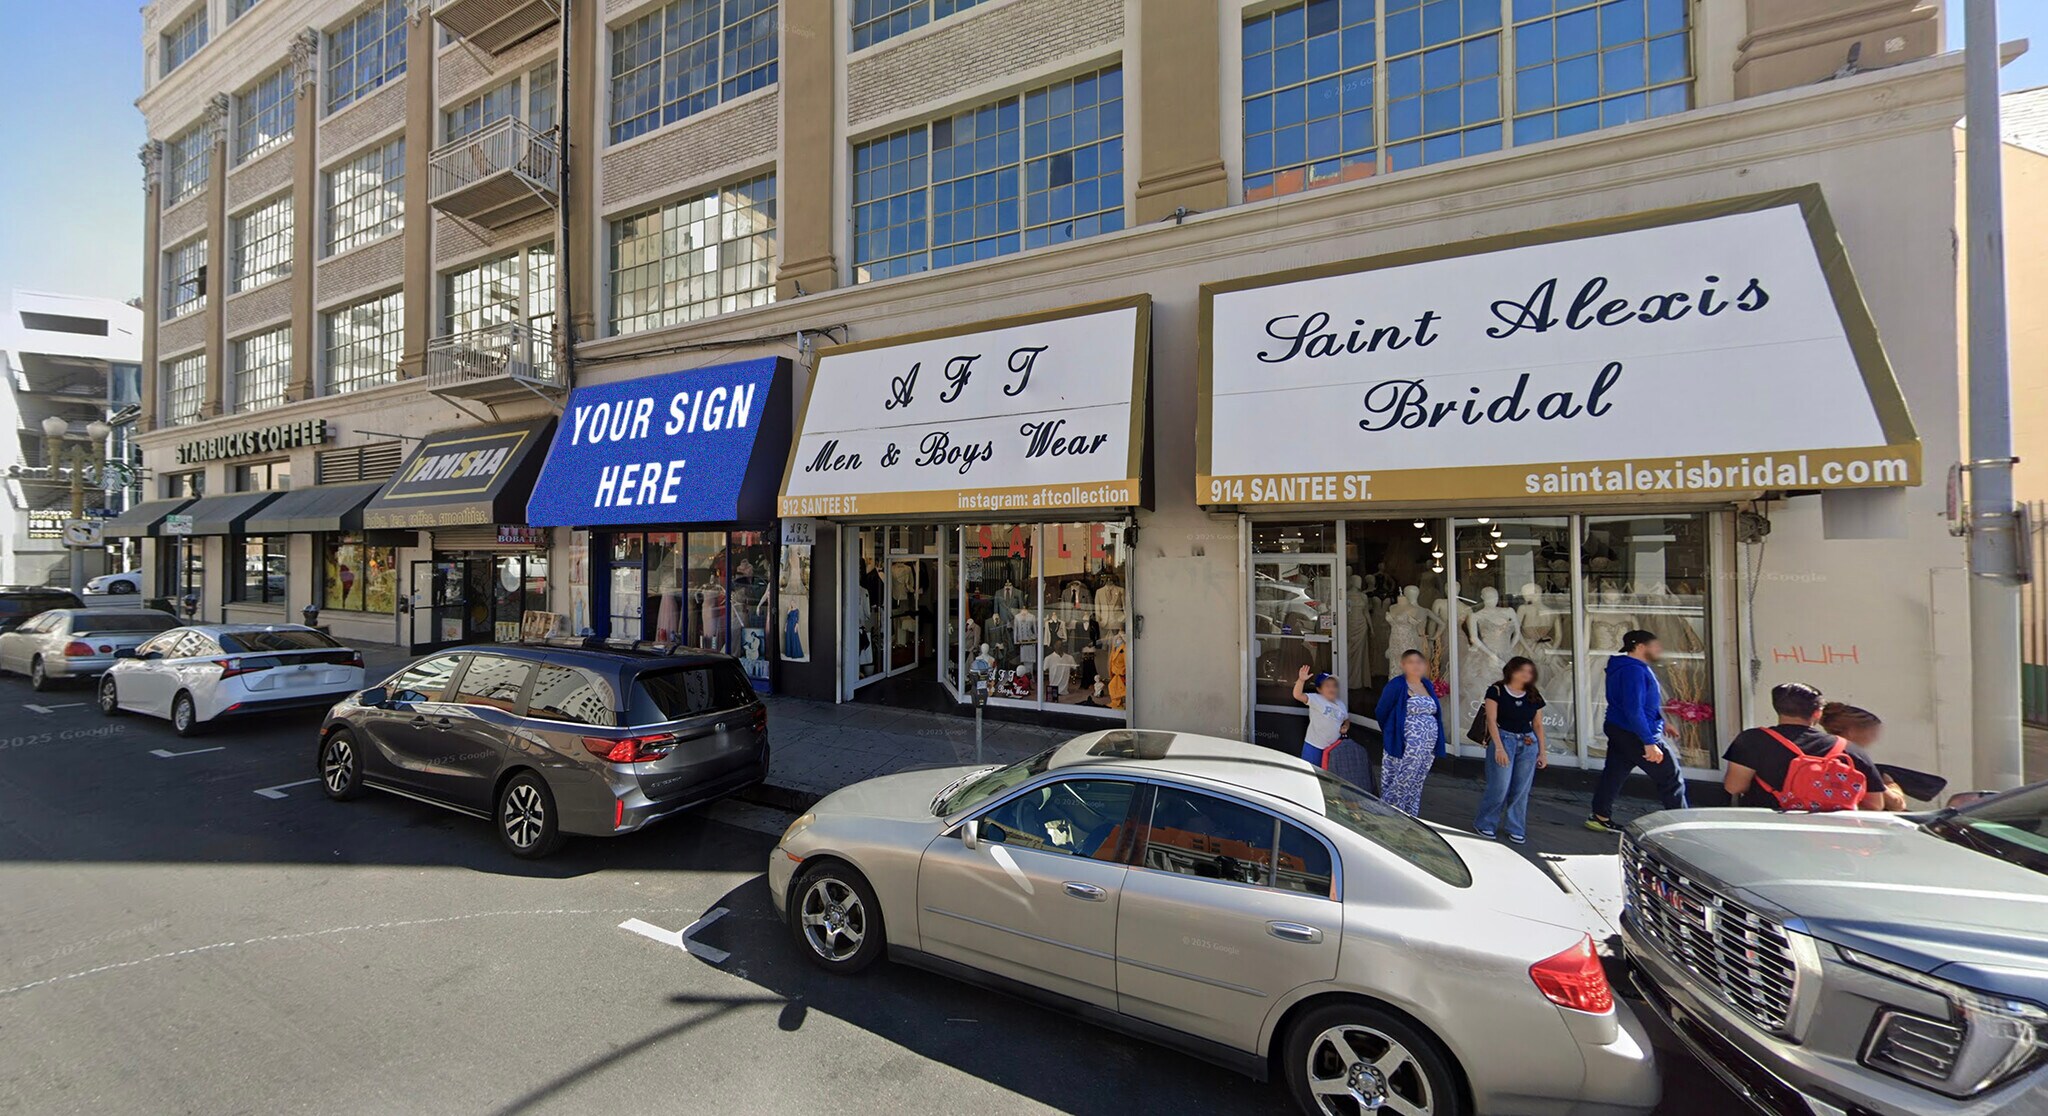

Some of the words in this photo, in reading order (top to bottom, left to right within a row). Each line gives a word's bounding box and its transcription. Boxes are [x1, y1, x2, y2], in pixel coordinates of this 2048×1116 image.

[1257, 310, 1441, 363] Saint
[1486, 275, 1771, 340] Alexis
[571, 397, 655, 446] YOUR
[665, 383, 756, 436] SIGN
[1358, 361, 1623, 432] Bridal
[176, 430, 255, 464] STARBUCKS
[258, 419, 323, 452] COFFEE
[805, 440, 862, 473] Men
[880, 443, 901, 467] &
[915, 431, 993, 475] Boys
[1020, 419, 1108, 459] Wear
[404, 446, 509, 483] YAMISHA
[594, 459, 686, 508] HERE
[1525, 455, 1909, 494] saintalexisbridal.com
[782, 499, 799, 515] 912
[801, 497, 841, 515] SANTEE
[843, 496, 859, 513] ST.
[958, 493, 1028, 511] instagram:
[1032, 485, 1129, 506] aftcollection
[1211, 479, 1244, 502] 914
[1251, 476, 1337, 502] SANTEE
[1343, 475, 1372, 500] ST.
[439, 506, 489, 526] smoothies.
[498, 535, 525, 543] BOBA
[978, 523, 1106, 558] SALE
